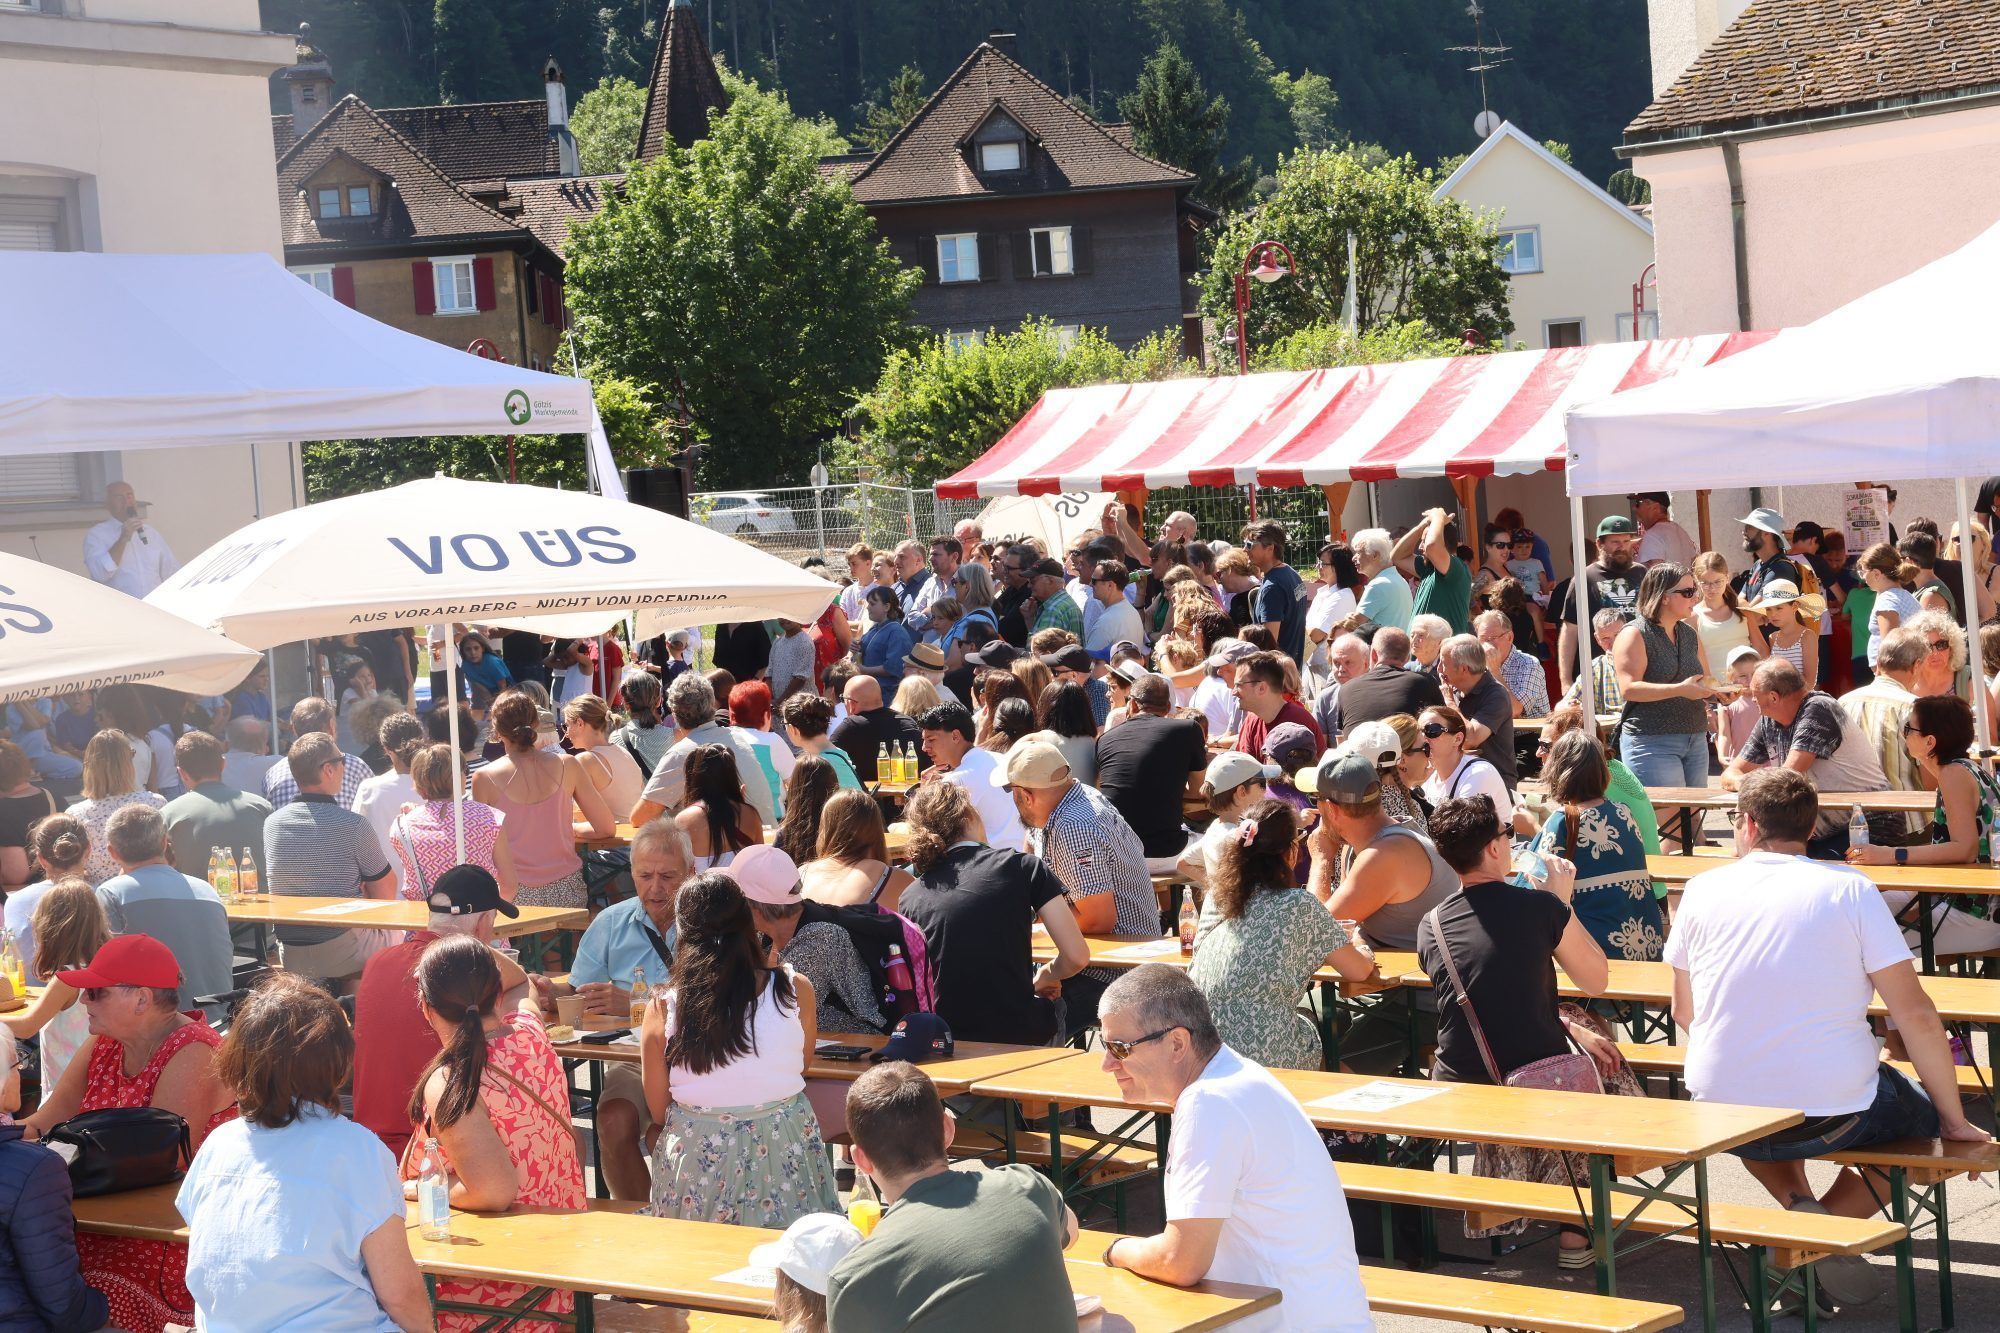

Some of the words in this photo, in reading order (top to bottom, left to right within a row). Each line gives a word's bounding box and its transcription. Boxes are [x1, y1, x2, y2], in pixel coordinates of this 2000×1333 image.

[533, 400, 552, 409] Götzis
[0, 584, 53, 640] S
[350, 612, 388, 624] AUS
[393, 601, 518, 619] VORARLBERG
[536, 597, 591, 609] NICHT
[596, 594, 633, 606] VON
[3, 686, 51, 703] NICHT
